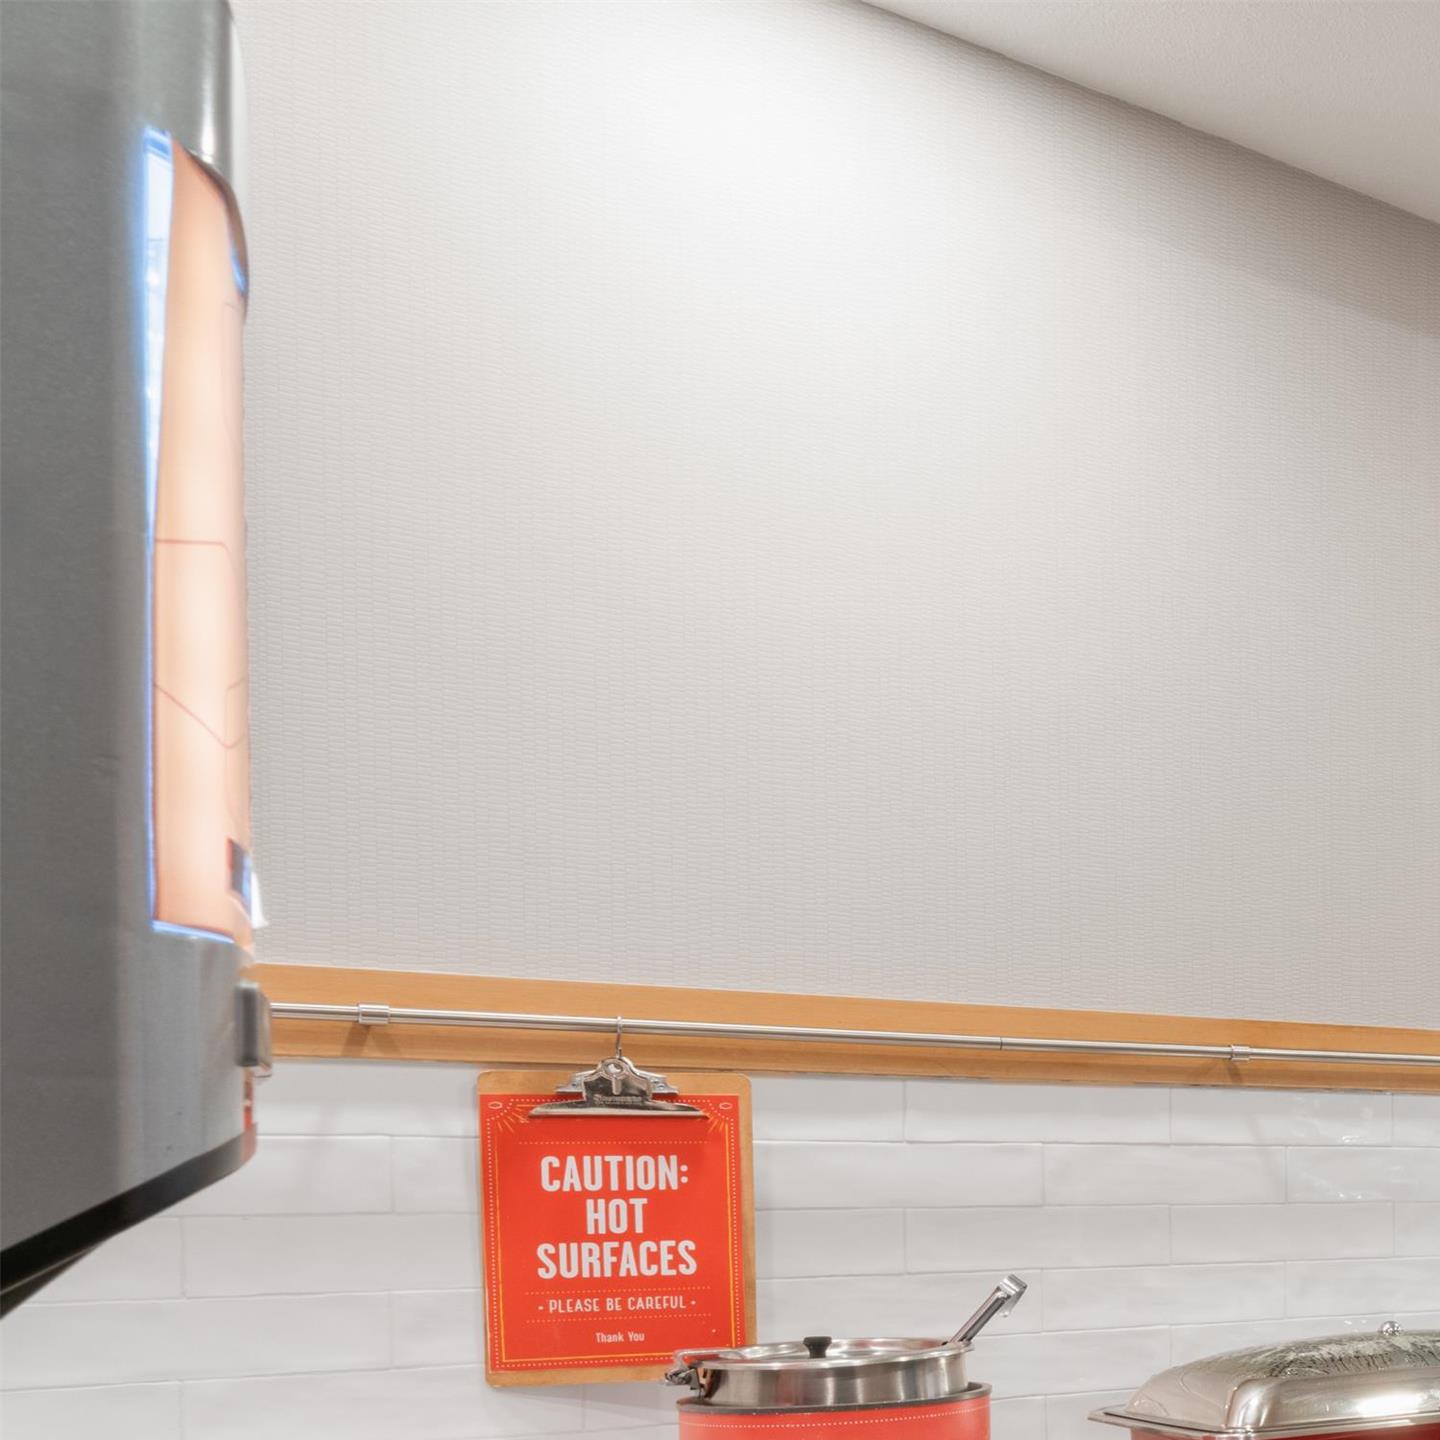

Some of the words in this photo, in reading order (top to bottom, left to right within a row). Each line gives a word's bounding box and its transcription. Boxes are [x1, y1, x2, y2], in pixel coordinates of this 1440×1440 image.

[540, 1155, 689, 1192] CAUTION:
[586, 1198, 648, 1235] HOT
[536, 1240, 697, 1280] SURFACES
[549, 1298, 600, 1313] PLEASE
[606, 1297, 623, 1311] BE
[627, 1295, 687, 1310] CAREFUL
[595, 1332, 624, 1343] Thank
[628, 1331, 645, 1342] You
